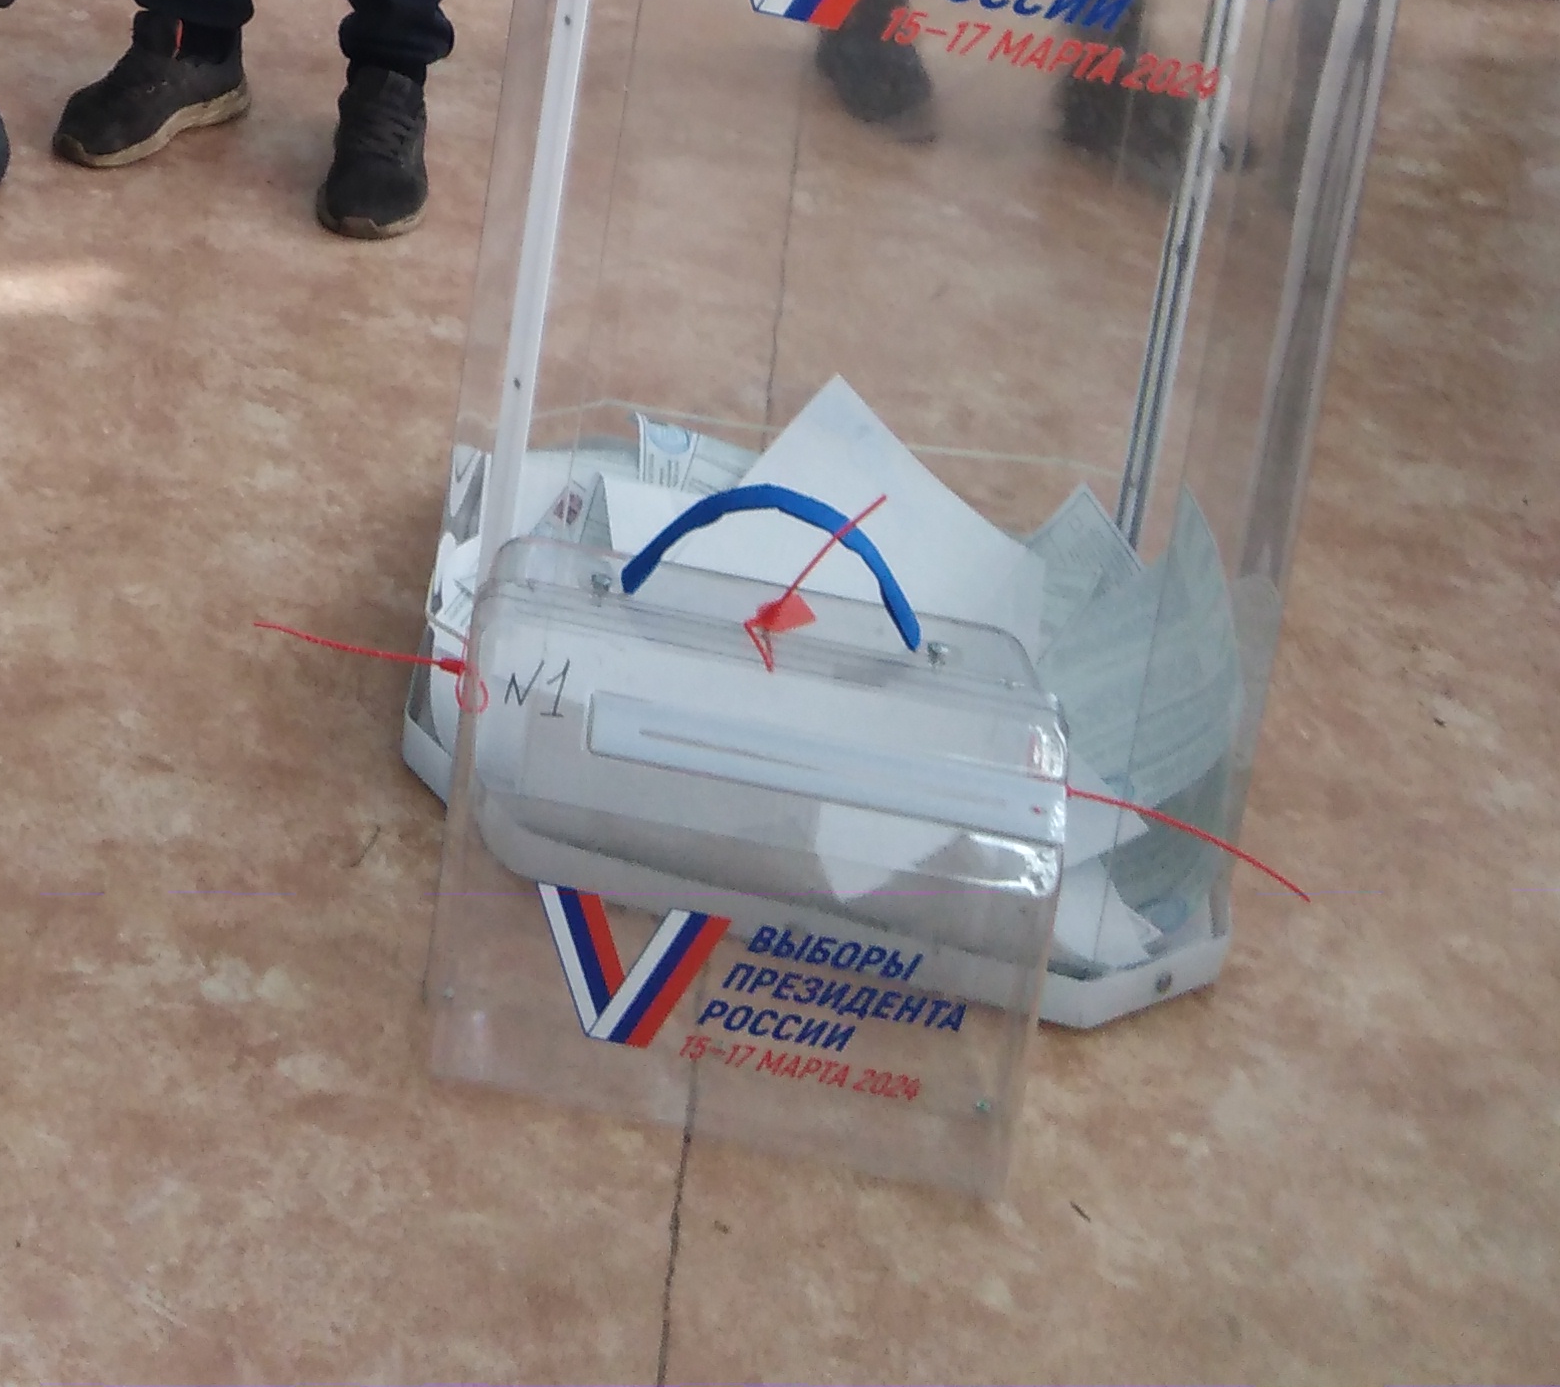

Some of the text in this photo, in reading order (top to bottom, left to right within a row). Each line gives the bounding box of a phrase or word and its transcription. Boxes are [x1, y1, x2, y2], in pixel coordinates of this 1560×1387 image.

[988, 28, 1125, 86] МАРТА
[1120, 53, 1221, 100] 2024
[748, 925, 924, 982] ВЫБОРЫ
[696, 999, 857, 1053] РОССИИ
[722, 962, 968, 1033] ПРЕЗИДЕНТА
[755, 1049, 851, 1088] МАРТА
[852, 1069, 922, 1102] 2024
